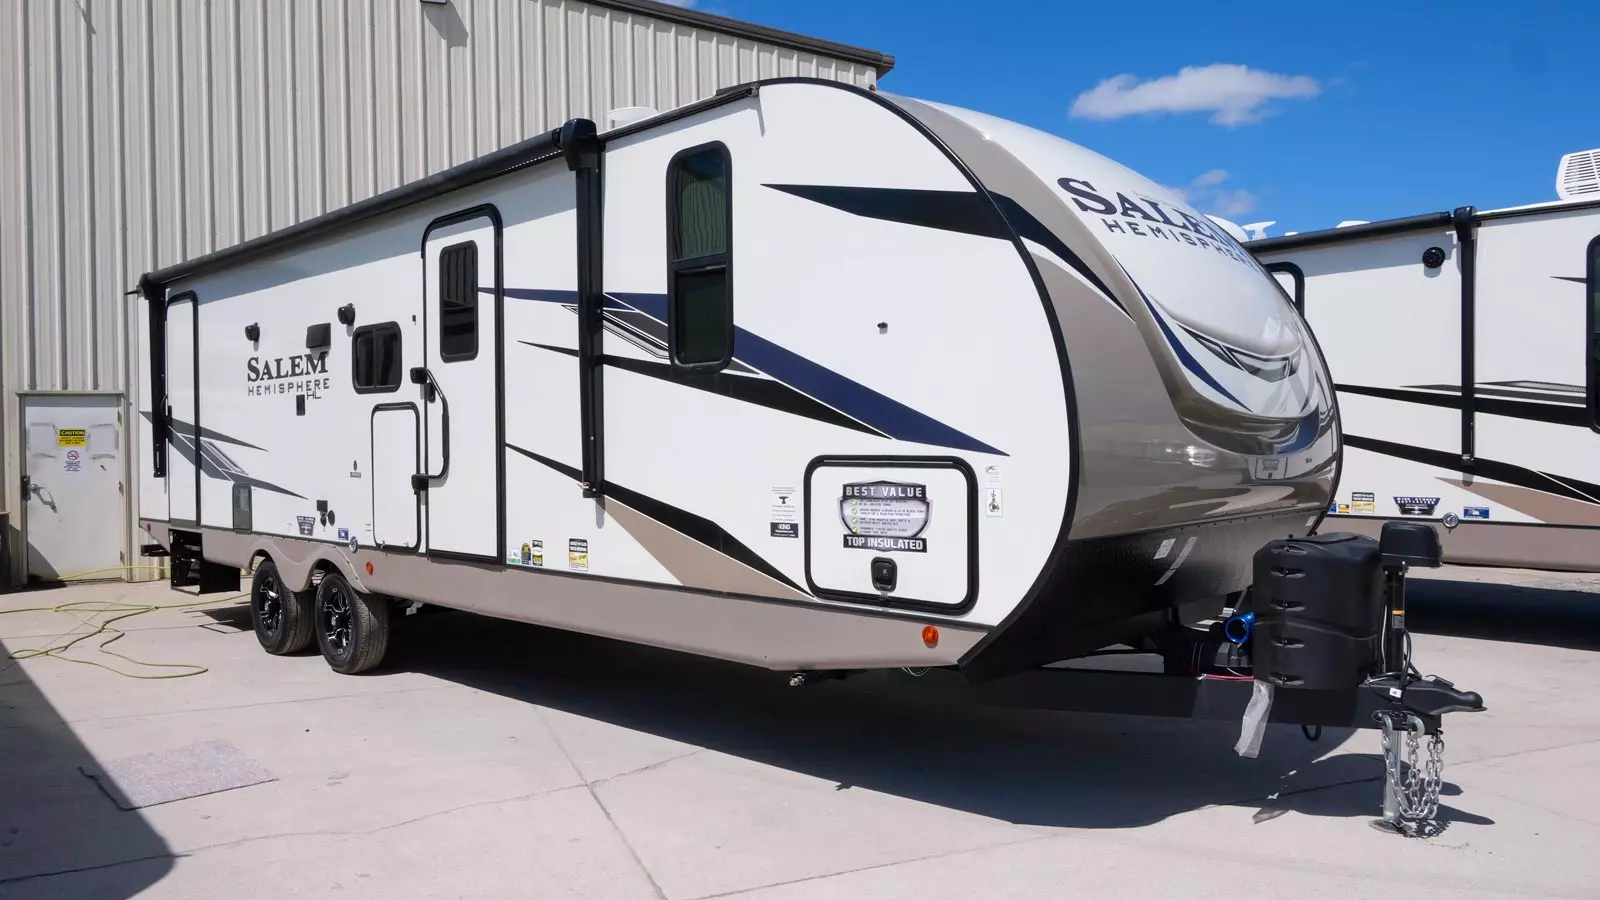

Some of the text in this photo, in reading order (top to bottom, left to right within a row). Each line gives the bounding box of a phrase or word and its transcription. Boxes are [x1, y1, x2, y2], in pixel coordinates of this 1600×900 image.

[247, 351, 328, 382] SALEM
[248, 378, 330, 396] HEMISPHERE
[306, 391, 322, 400] HL
[846, 486, 923, 497] BEST VALUE
[846, 536, 924, 550] TOP INSULATED
